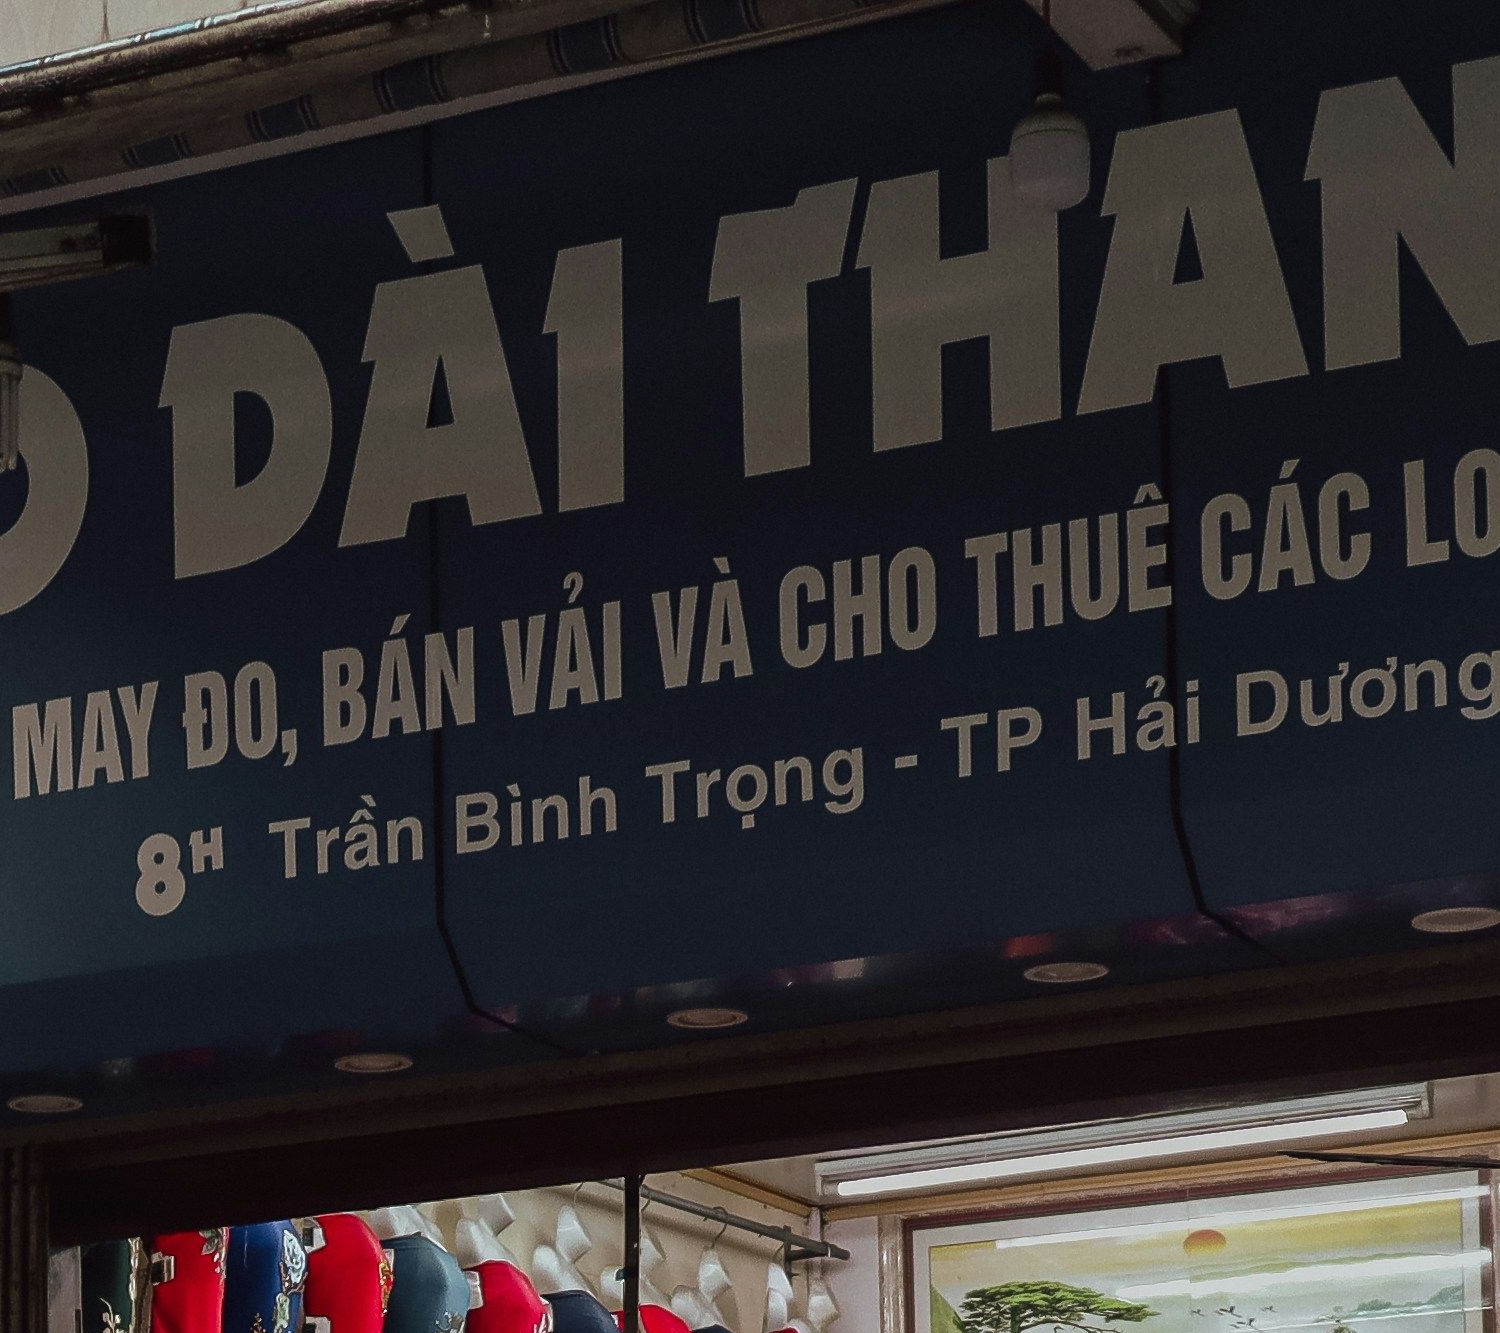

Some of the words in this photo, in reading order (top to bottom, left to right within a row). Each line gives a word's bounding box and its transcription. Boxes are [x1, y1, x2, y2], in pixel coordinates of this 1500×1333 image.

[157, 204, 626, 580] DÀI
[11, 680, 160, 802] MAY
[181, 658, 300, 770] ĐO,
[320, 612, 478, 749] BÁN
[501, 570, 624, 716] VẢI
[650, 555, 754, 692] VÀ
[777, 545, 937, 669] CHO
[963, 482, 1173, 642] THUÊ
[1199, 458, 1373, 601] CÁC
[268, 795, 425, 879] Trần
[454, 773, 620, 856] Bình
[645, 742, 867, 832] Trọng
[939, 702, 1044, 780] TP
[1075, 674, 1202, 762] Hải
